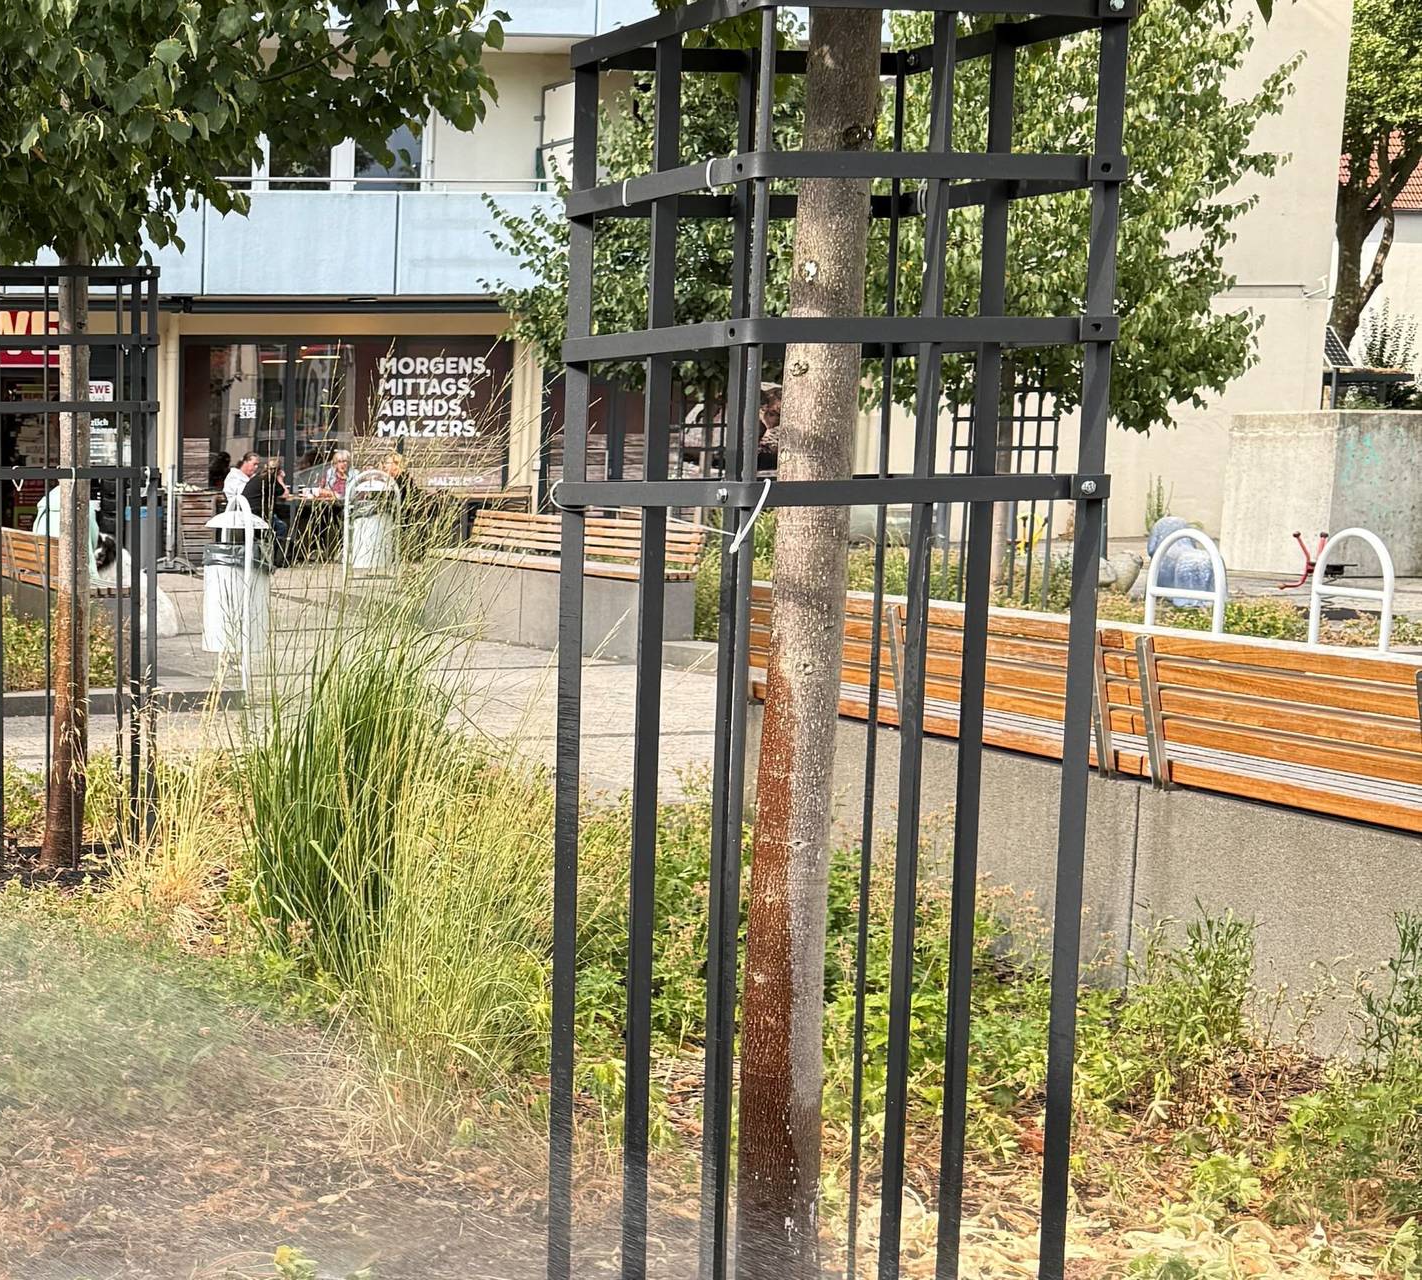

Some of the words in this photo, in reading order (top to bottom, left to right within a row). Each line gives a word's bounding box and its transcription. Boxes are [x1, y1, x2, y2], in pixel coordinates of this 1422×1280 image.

[379, 357, 491, 377] MORGENS,
[378, 378, 476, 398] MITTAGS,
[378, 399, 467, 419] ABENDS,
[378, 420, 481, 437] MALZERS.
